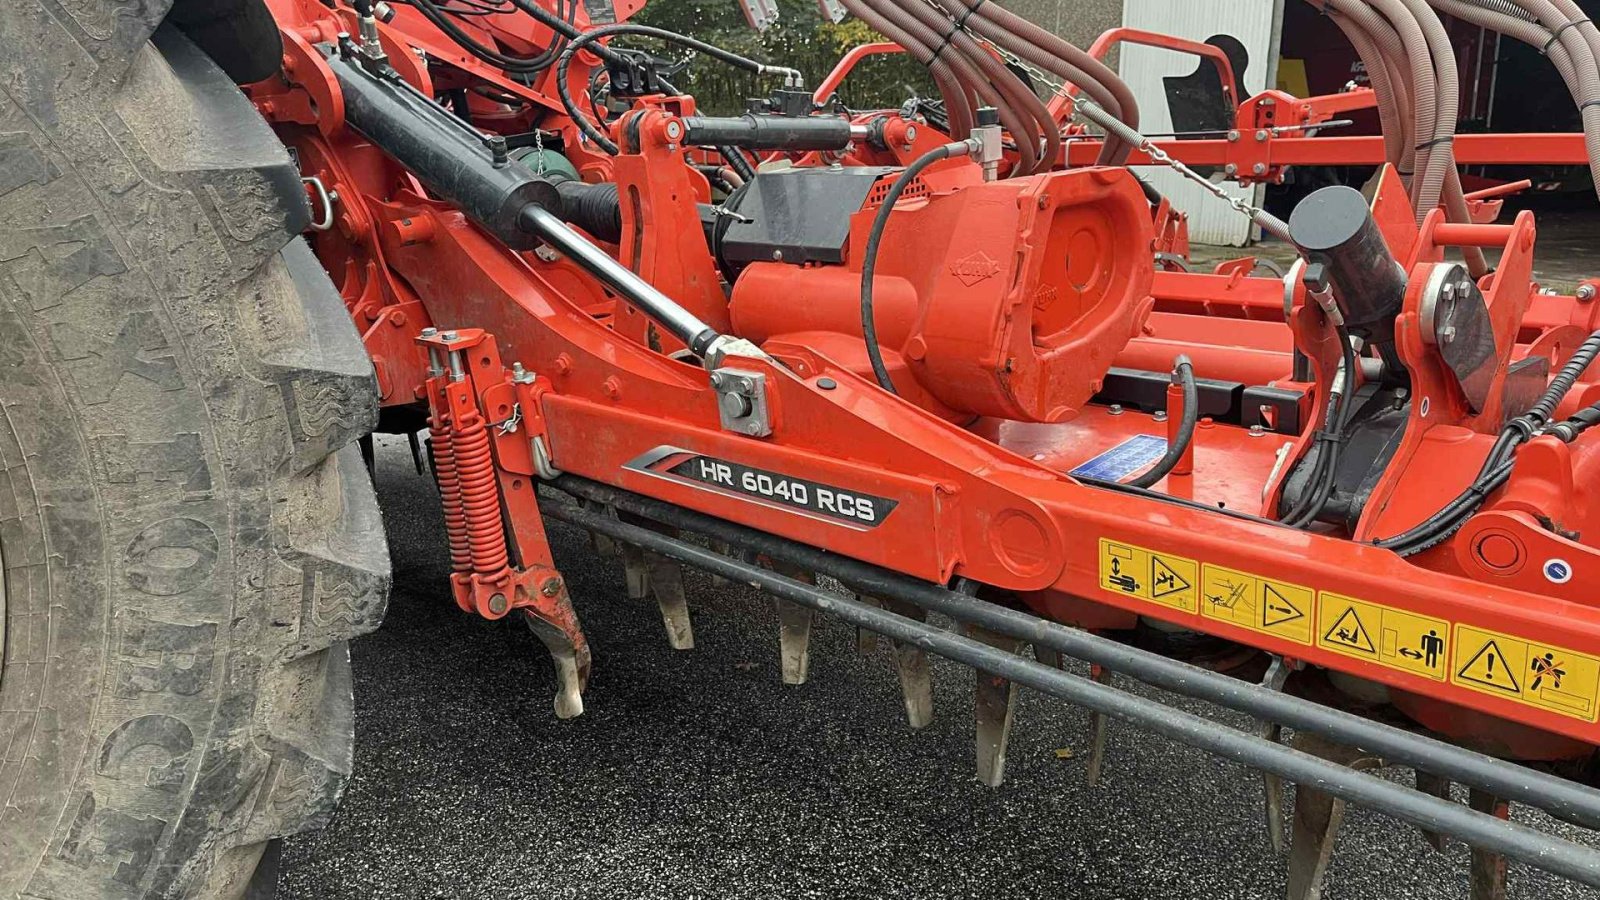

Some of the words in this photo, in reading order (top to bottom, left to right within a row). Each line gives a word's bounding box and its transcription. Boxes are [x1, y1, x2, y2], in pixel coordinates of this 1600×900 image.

[700, 459, 734, 486] HR
[742, 471, 808, 504] 6040
[817, 488, 875, 521] RCS
[57, 432, 221, 888] FORCE
